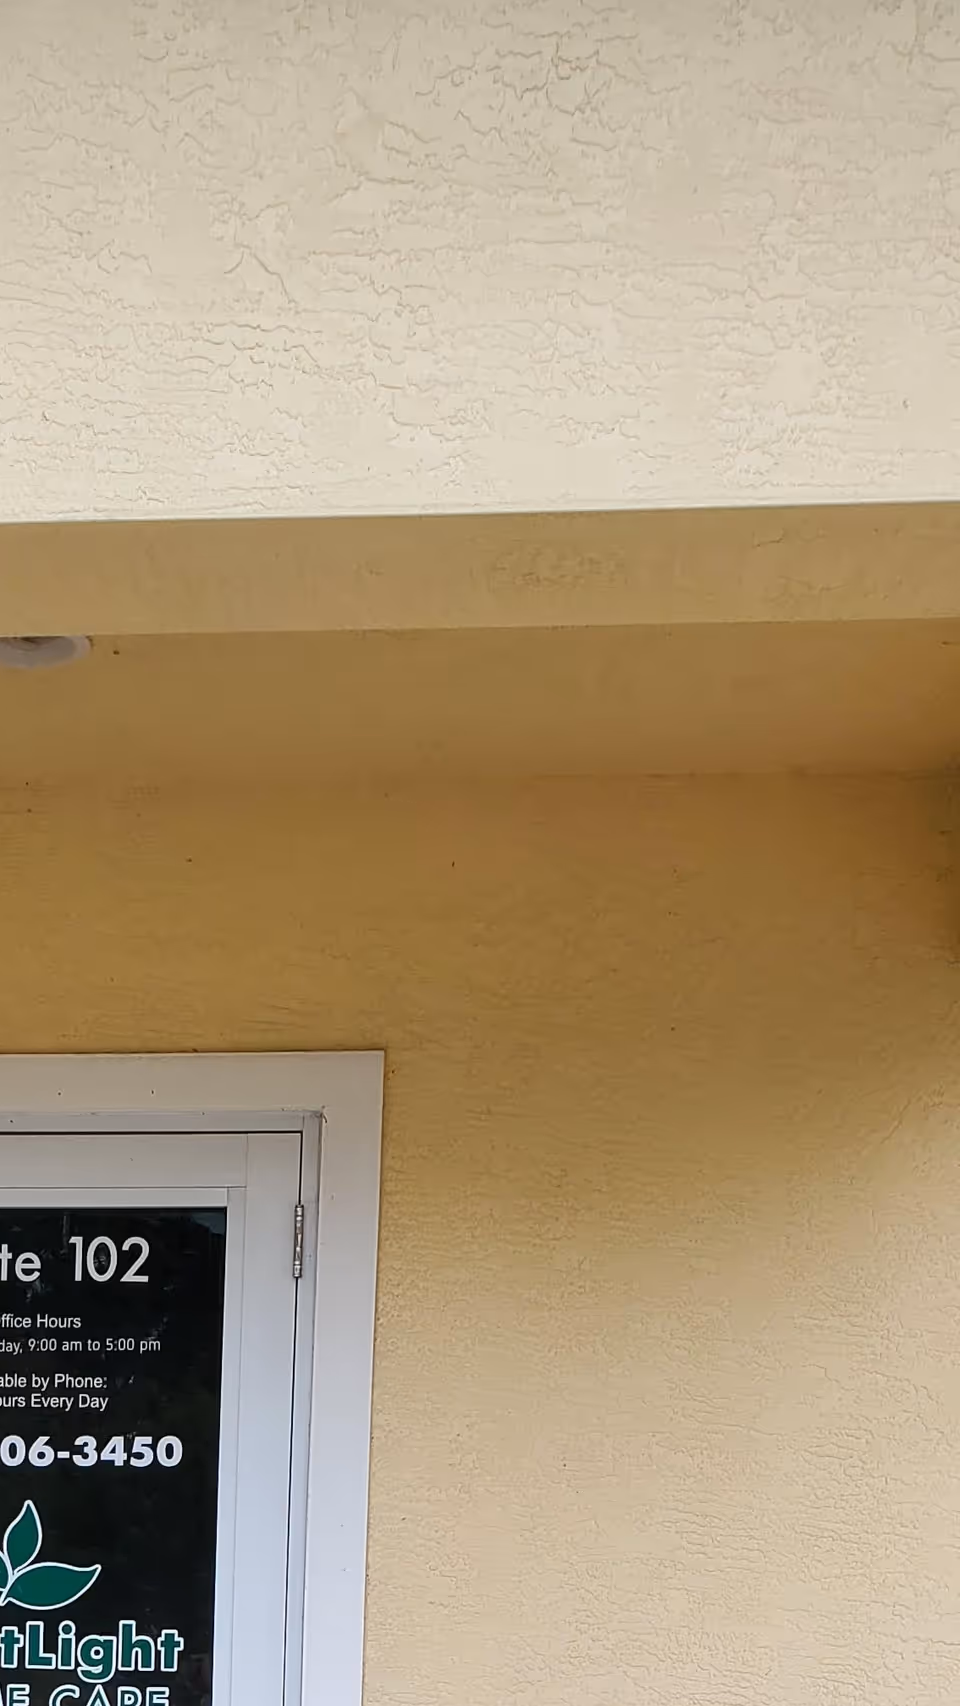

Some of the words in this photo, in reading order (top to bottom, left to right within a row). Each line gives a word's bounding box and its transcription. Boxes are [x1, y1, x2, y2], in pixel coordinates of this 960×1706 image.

[69, 1236, 150, 1283] 102
[37, 1315, 81, 1329] Hours
[28, 1339, 57, 1352] 9:00
[62, 1340, 82, 1351] am
[87, 1340, 101, 1351] to
[105, 1338, 135, 1351] 5:00
[139, 1340, 161, 1353] pm
[31, 1374, 49, 1391] by
[54, 1374, 107, 1388] Phone:
[30, 1394, 74, 1411] Every
[78, 1395, 108, 1411] Day
